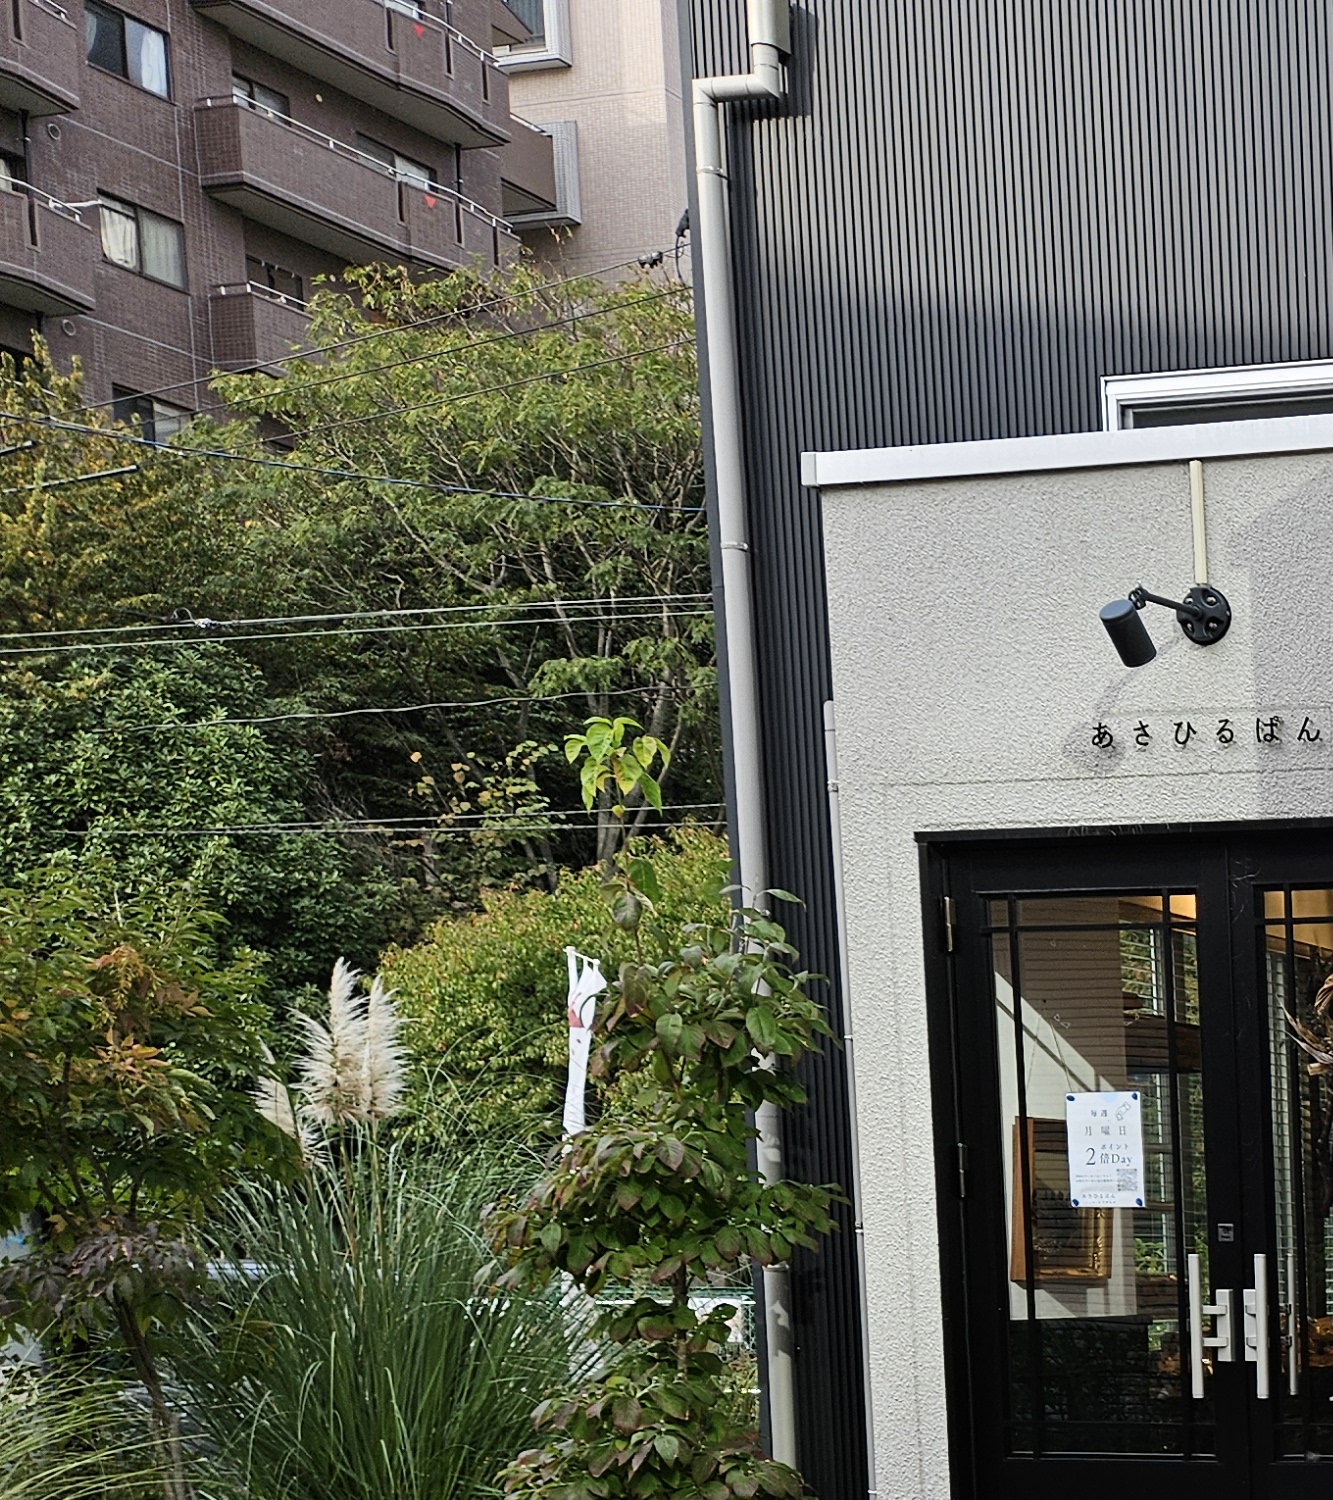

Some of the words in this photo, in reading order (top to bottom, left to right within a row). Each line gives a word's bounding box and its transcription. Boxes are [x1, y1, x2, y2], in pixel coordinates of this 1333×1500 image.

[1091, 715, 1323, 749] あさひるぱん
[1085, 1147, 1096, 1166] 2
